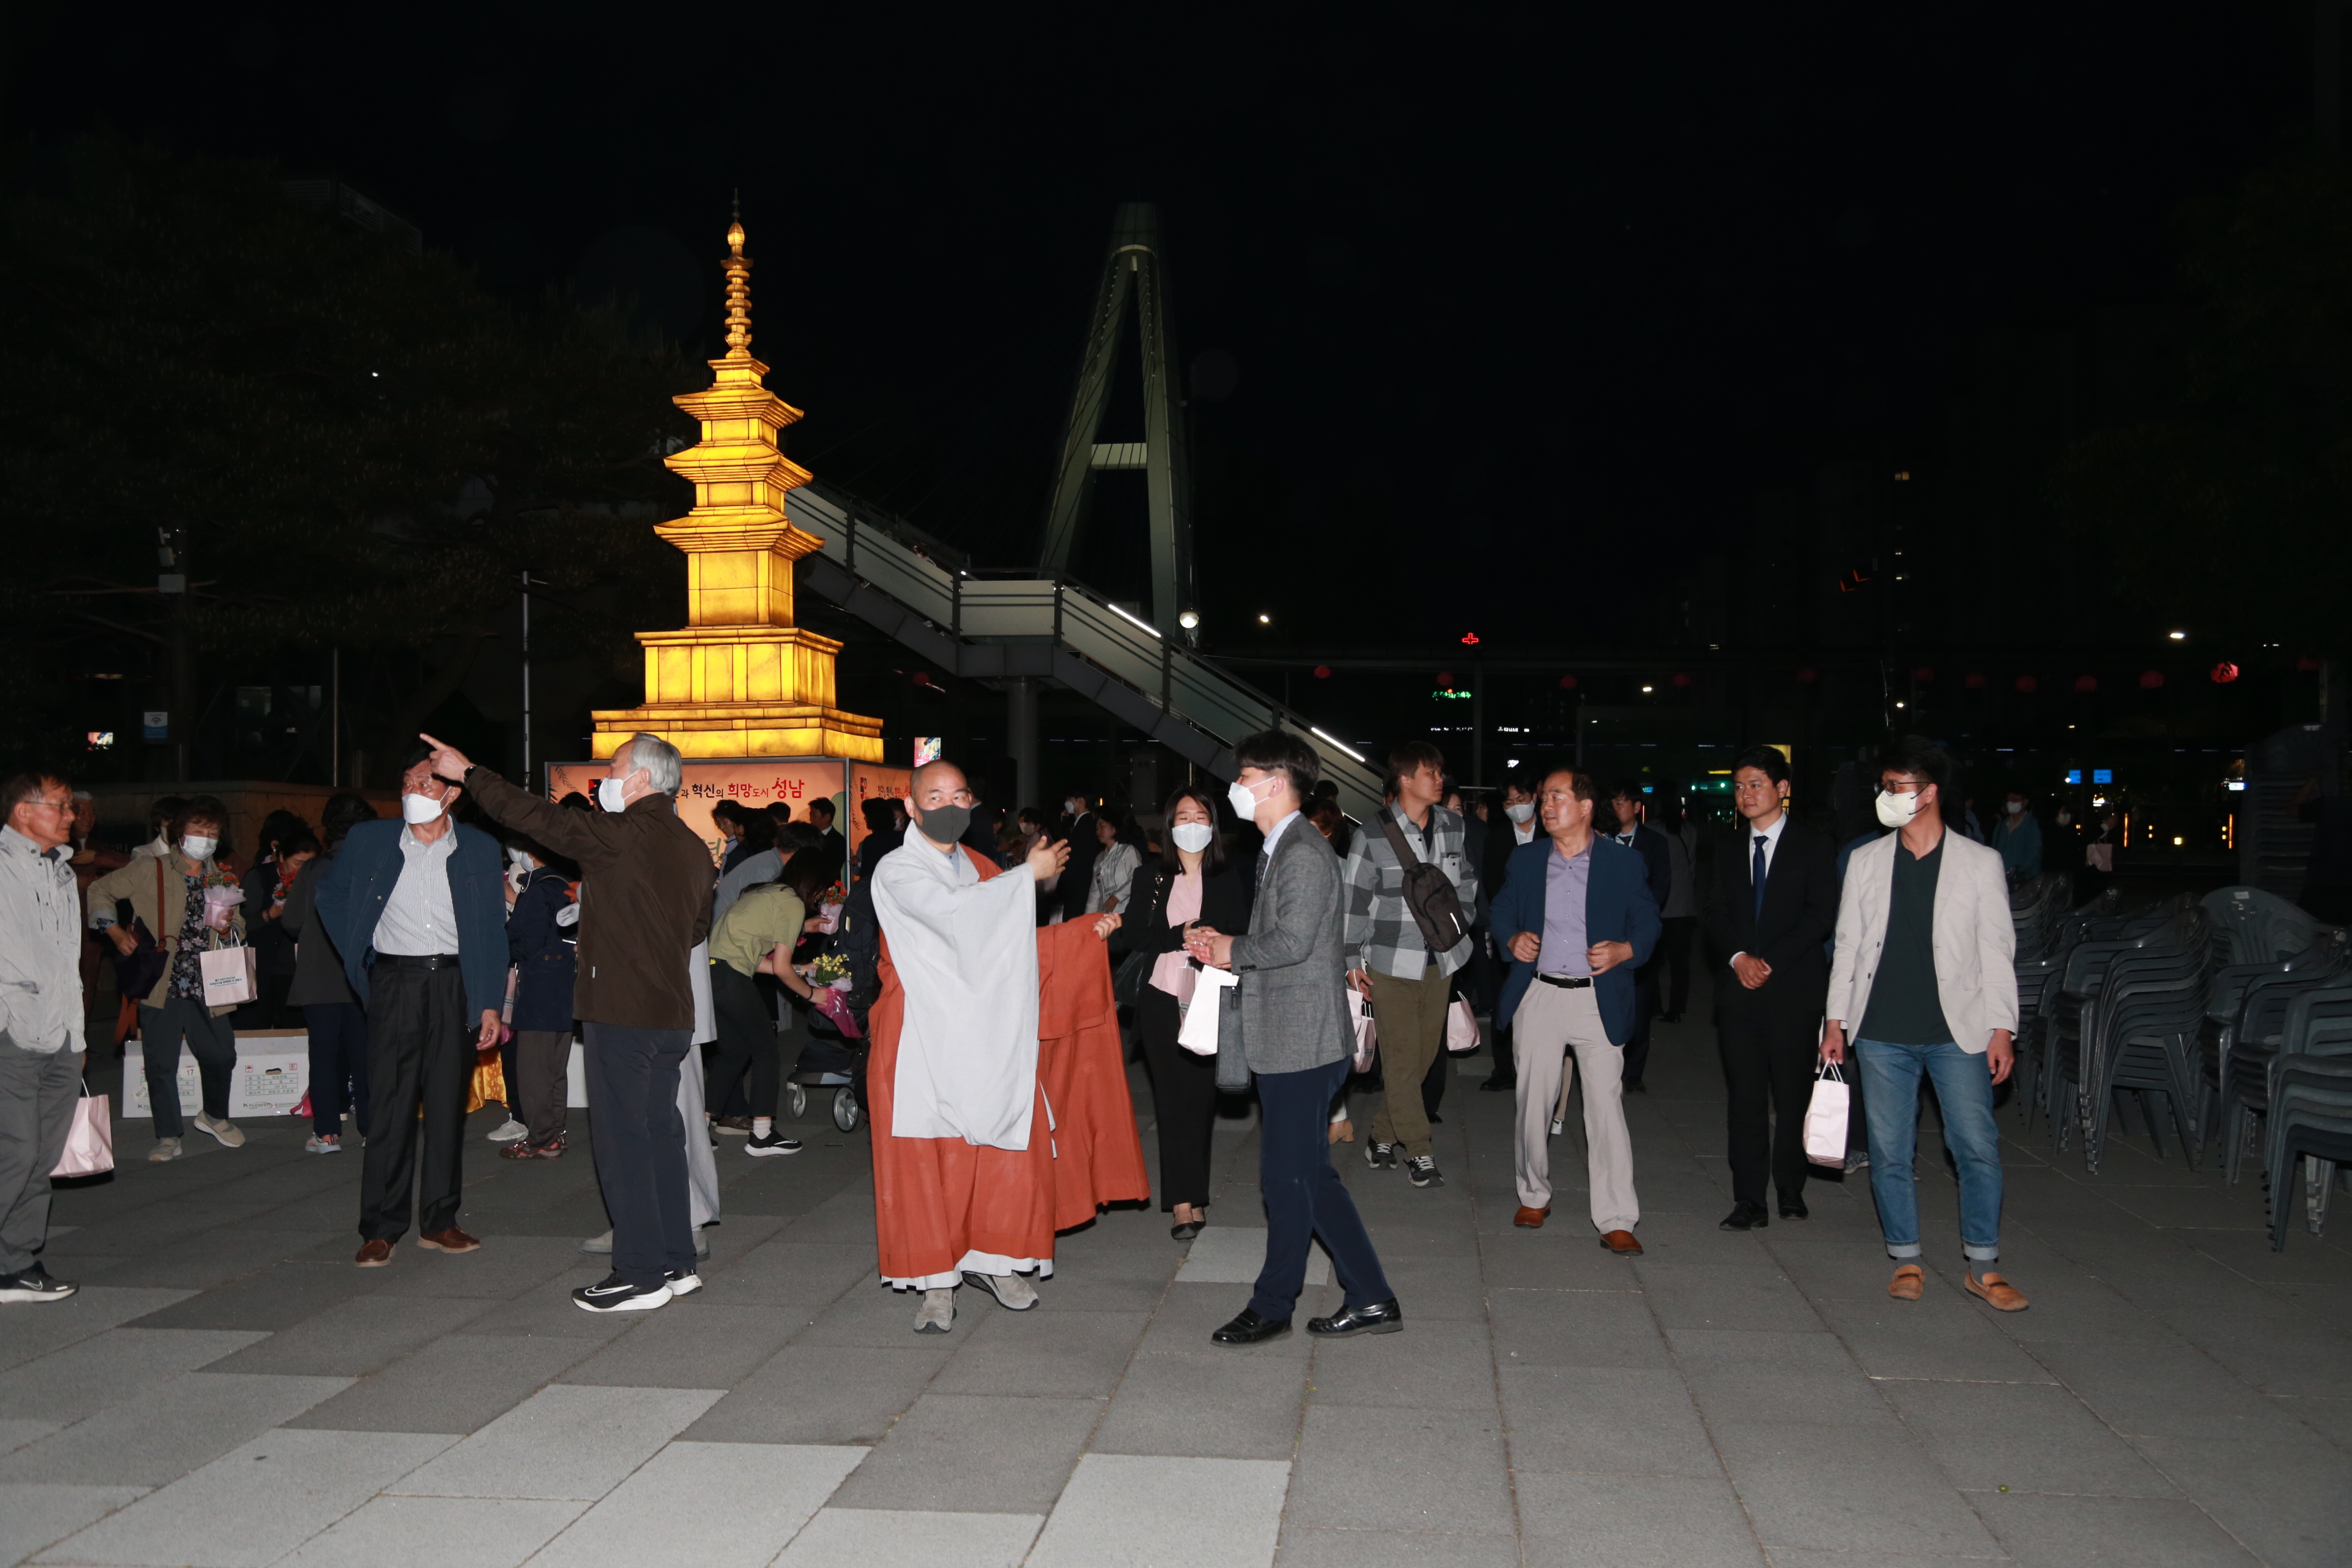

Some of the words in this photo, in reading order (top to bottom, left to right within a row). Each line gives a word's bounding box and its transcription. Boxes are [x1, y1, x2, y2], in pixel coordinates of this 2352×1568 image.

[692, 783, 724, 798] 혁신의
[728, 783, 769, 798] 희망도시
[772, 777, 804, 799] 성남
[135, 1087, 146, 1097] 8019
